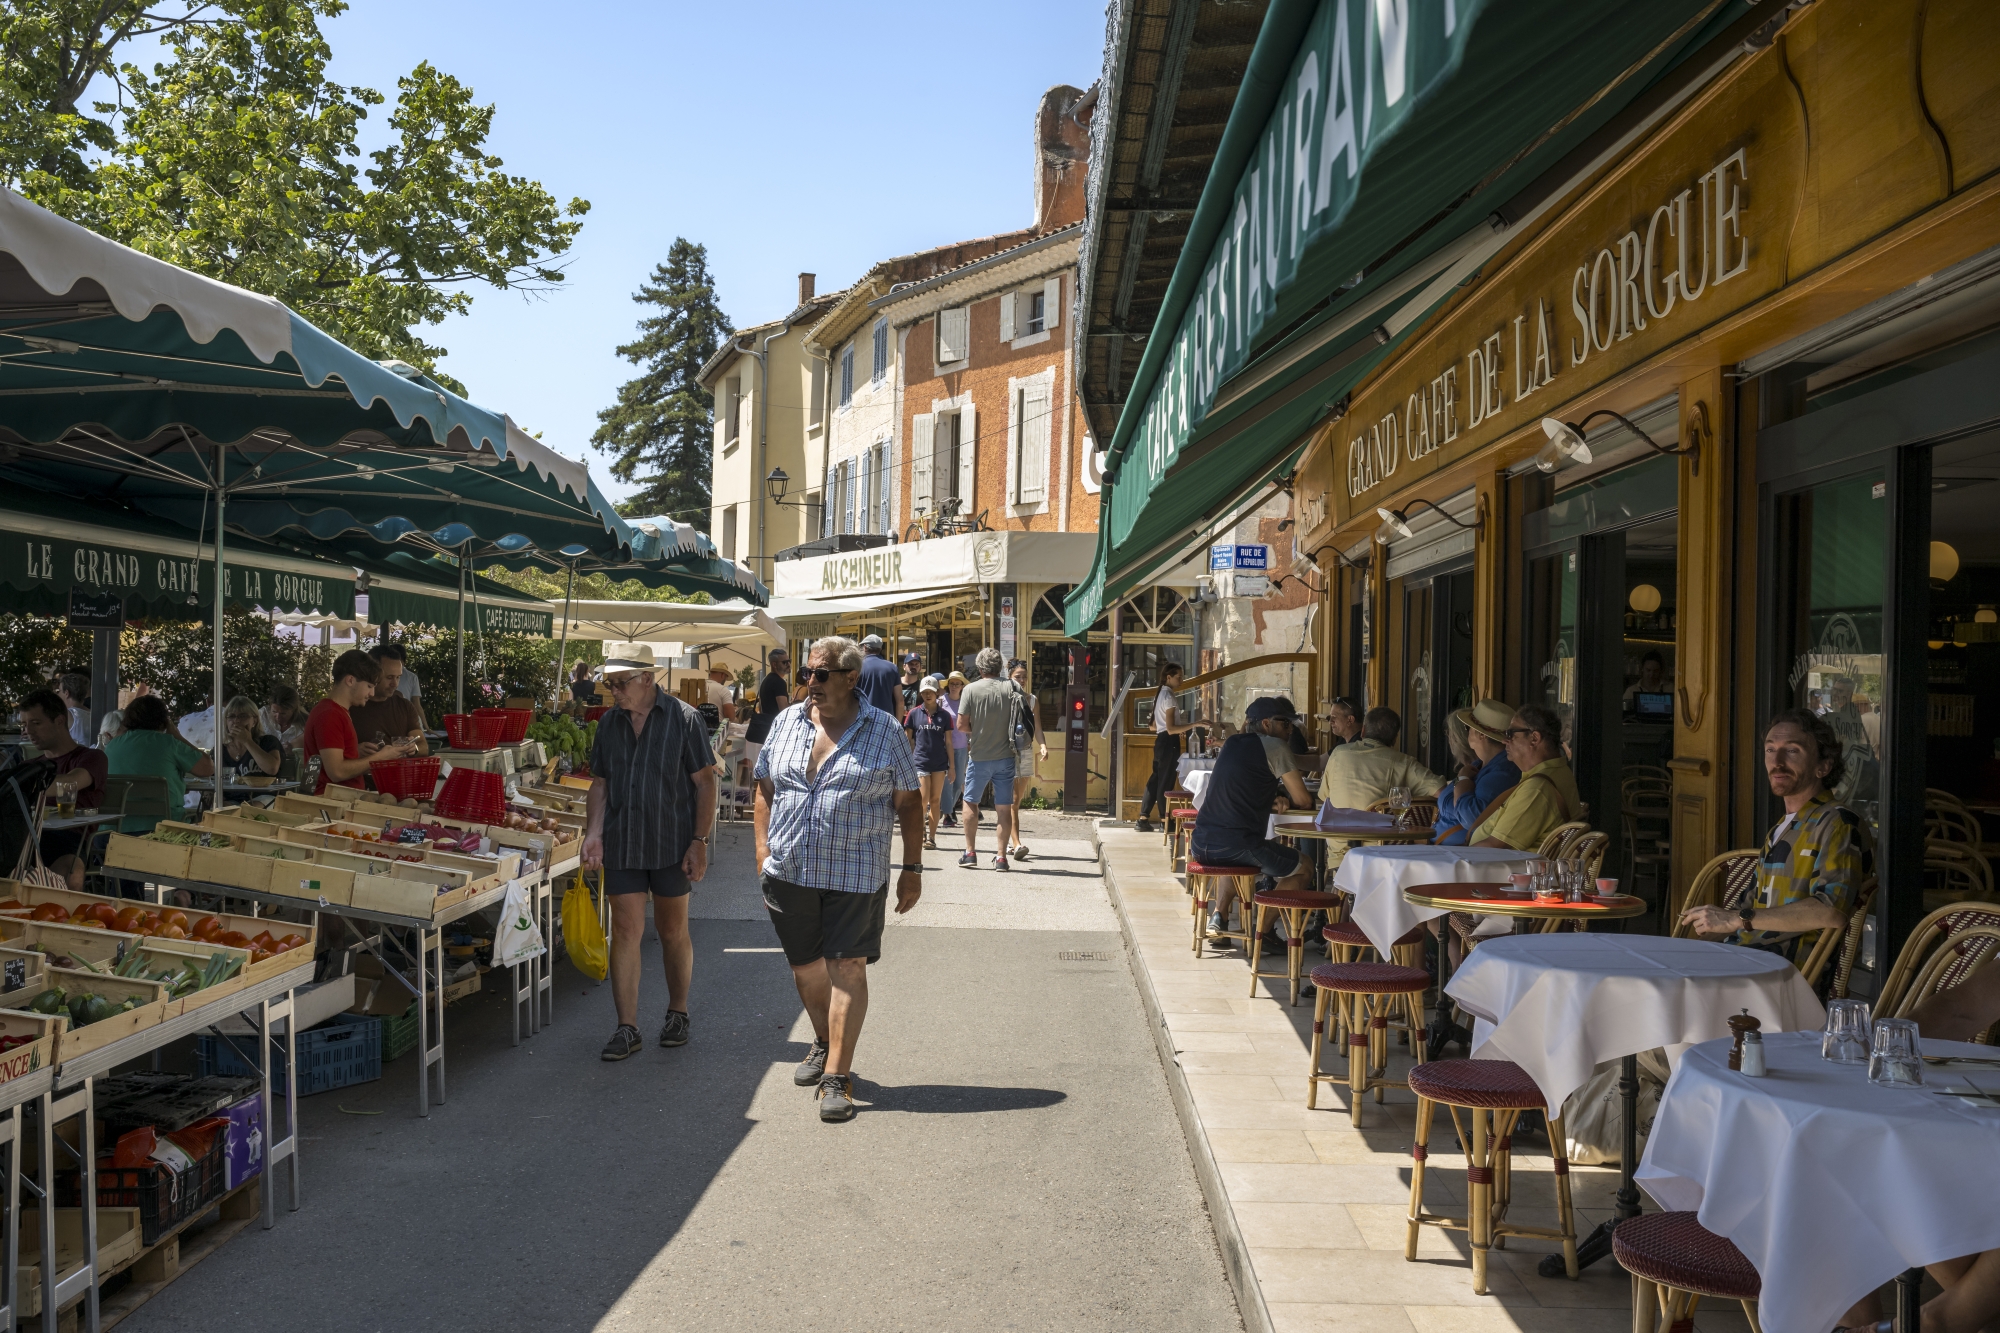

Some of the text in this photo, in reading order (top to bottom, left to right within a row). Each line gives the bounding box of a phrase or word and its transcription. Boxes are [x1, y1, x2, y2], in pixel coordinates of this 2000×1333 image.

[1178, 328, 1188, 436] &
[1193, 0, 1456, 407] RESTAURAN
[1348, 146, 1749, 498] GRAND CAFE DE LA SORGUE
[1236, 557, 1242, 566] LA
[1242, 557, 1265, 567] RÉPUBLIQUE
[1240, 548, 1262, 557] RUE DE
[26, 542, 324, 606] LE GRAND CAFÉ E LA SORGUE
[821, 550, 903, 592] AU CHINEUR
[486, 607, 547, 631] CAFÉ & RESTAURANT
[792, 621, 830, 637] RESTAURANT
[0, 1052, 31, 1083] NCE
